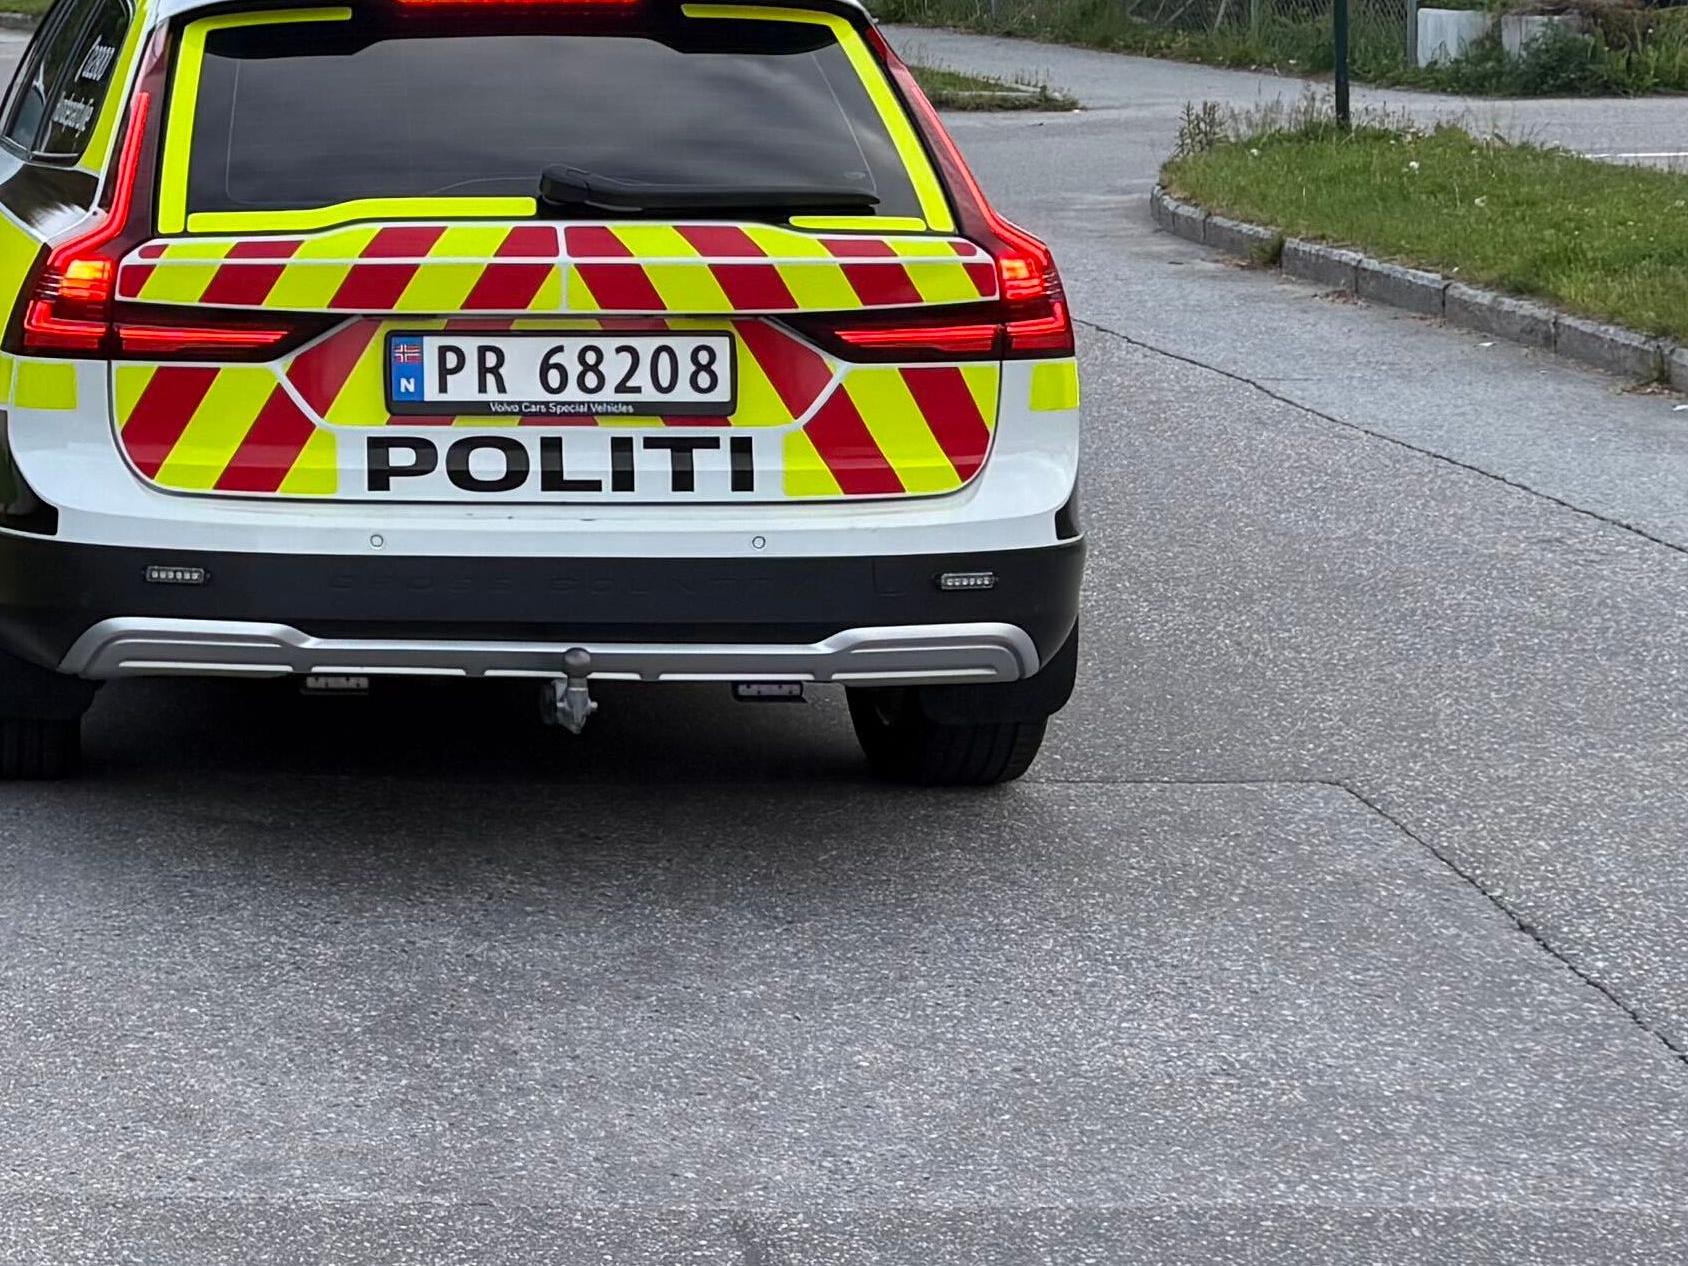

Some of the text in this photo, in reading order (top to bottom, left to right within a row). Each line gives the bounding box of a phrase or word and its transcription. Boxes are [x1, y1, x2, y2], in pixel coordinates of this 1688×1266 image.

[401, 378, 414, 392] N
[438, 345, 718, 394] PR 68208
[490, 402, 634, 414] Volvo Cars Special Vehicles
[367, 436, 754, 492] POLITI
